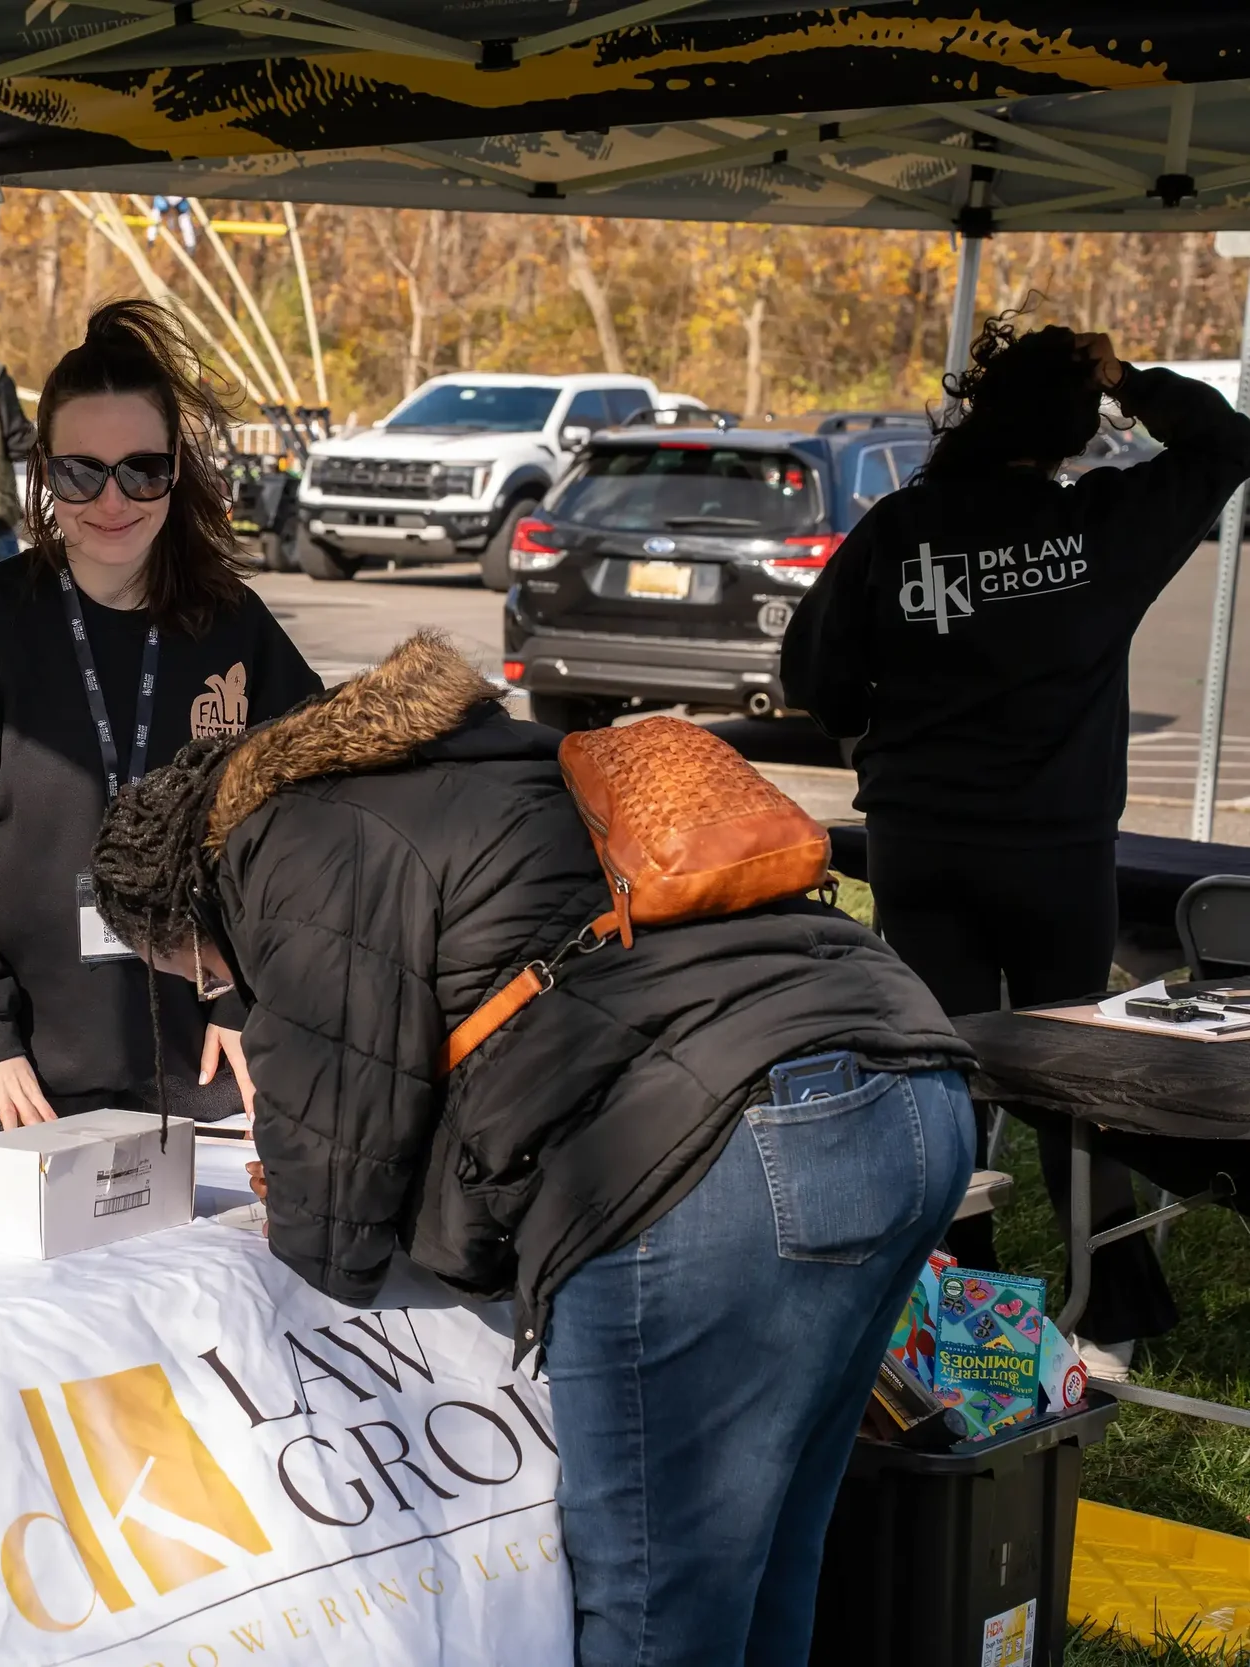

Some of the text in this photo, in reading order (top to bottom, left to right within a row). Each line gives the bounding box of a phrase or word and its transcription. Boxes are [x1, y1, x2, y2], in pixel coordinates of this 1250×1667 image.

[978, 533, 1083, 570] DK LAW
[980, 559, 1088, 593] GROUP
[199, 698, 245, 725] FALL
[197, 1306, 435, 1428] LAW
[939, 1350, 1035, 1377] DOMINOES
[941, 1366, 1020, 1386] BUTTERFLY
[1011, 1385, 1033, 1394] GIANT
[277, 1380, 560, 1528] GROU
[144, 1567, 445, 1667] OWERING
[986, 1619, 1004, 1640] HDX
